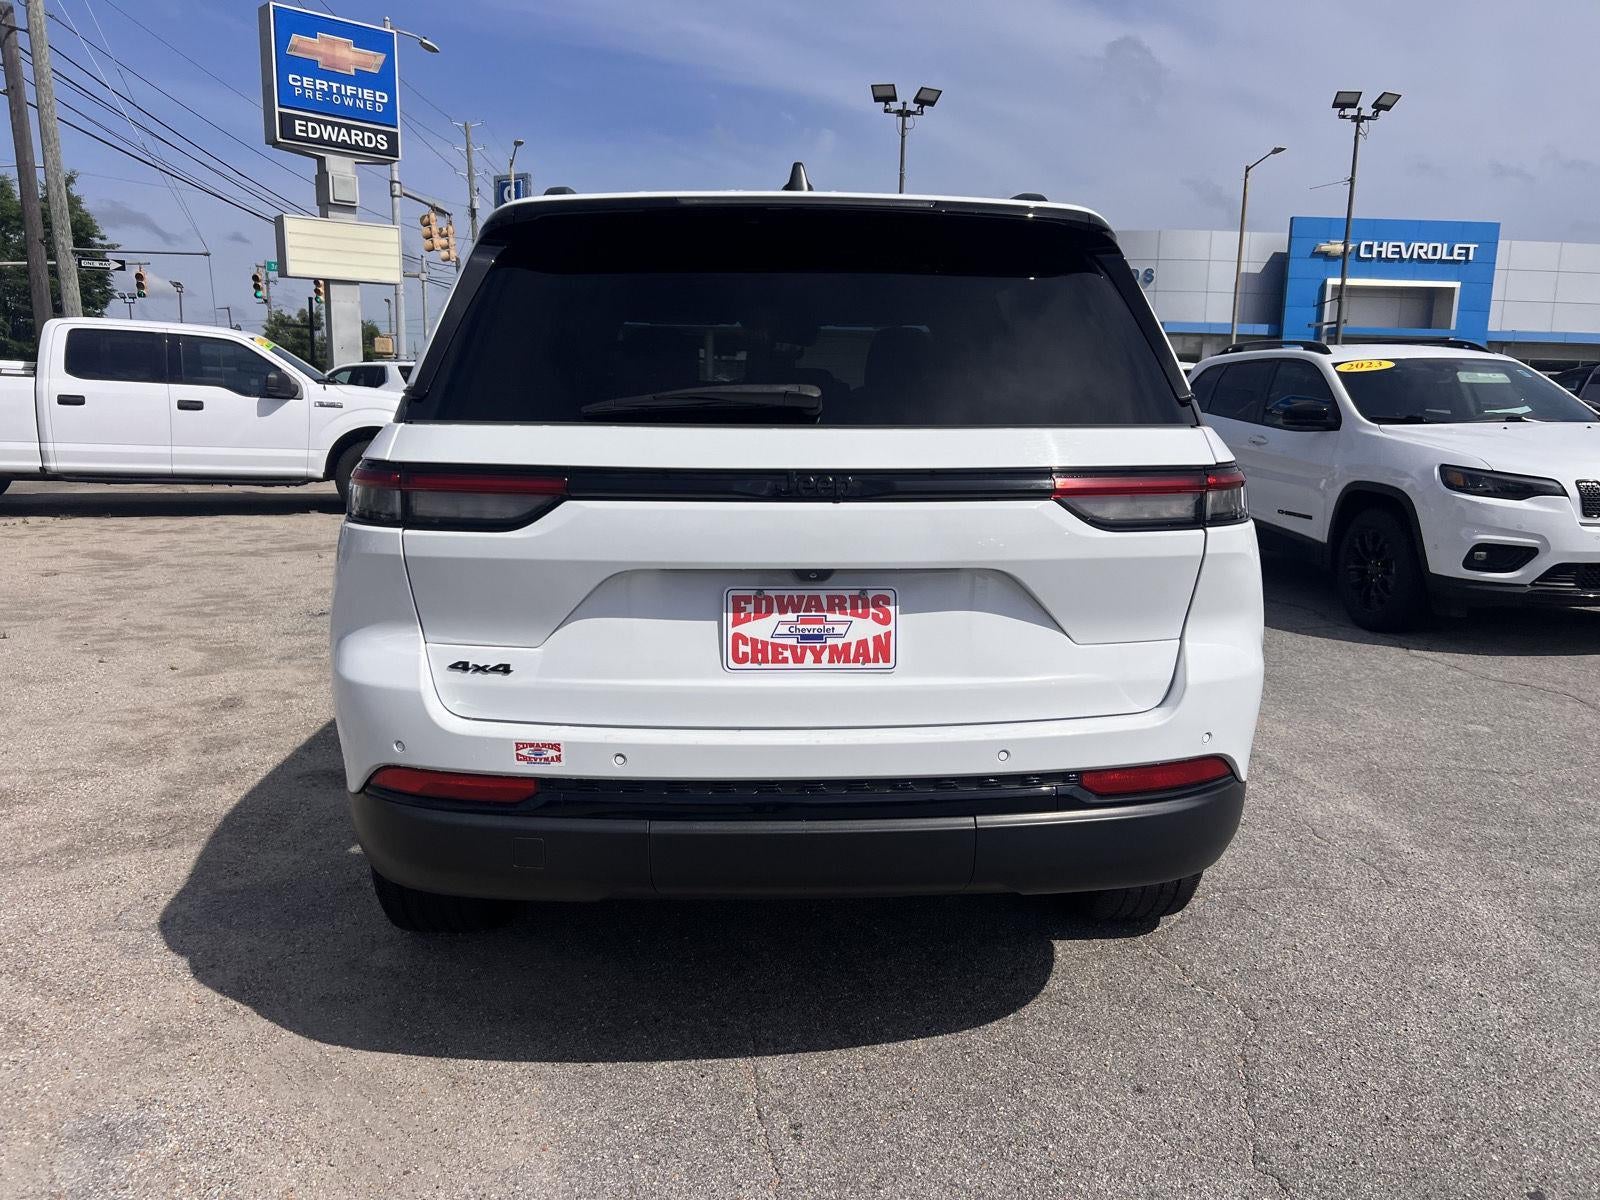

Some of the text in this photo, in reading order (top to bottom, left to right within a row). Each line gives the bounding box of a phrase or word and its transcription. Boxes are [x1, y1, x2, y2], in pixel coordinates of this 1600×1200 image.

[288, 73, 389, 103] CERTIFIED
[294, 88, 384, 113] PRE-OWNED
[294, 119, 388, 150] EDWARDS
[1359, 240, 1479, 261] CHEVROLET
[1346, 361, 1383, 371] 2023
[775, 471, 853, 504] Jeep
[731, 593, 892, 628] EDWARDS
[788, 625, 836, 635] Chevrolet
[731, 630, 892, 665] CHEVYMAN
[447, 660, 514, 676] 4x4
[515, 742, 561, 753] EDWARDS
[515, 752, 562, 763] CHEVYMAN
